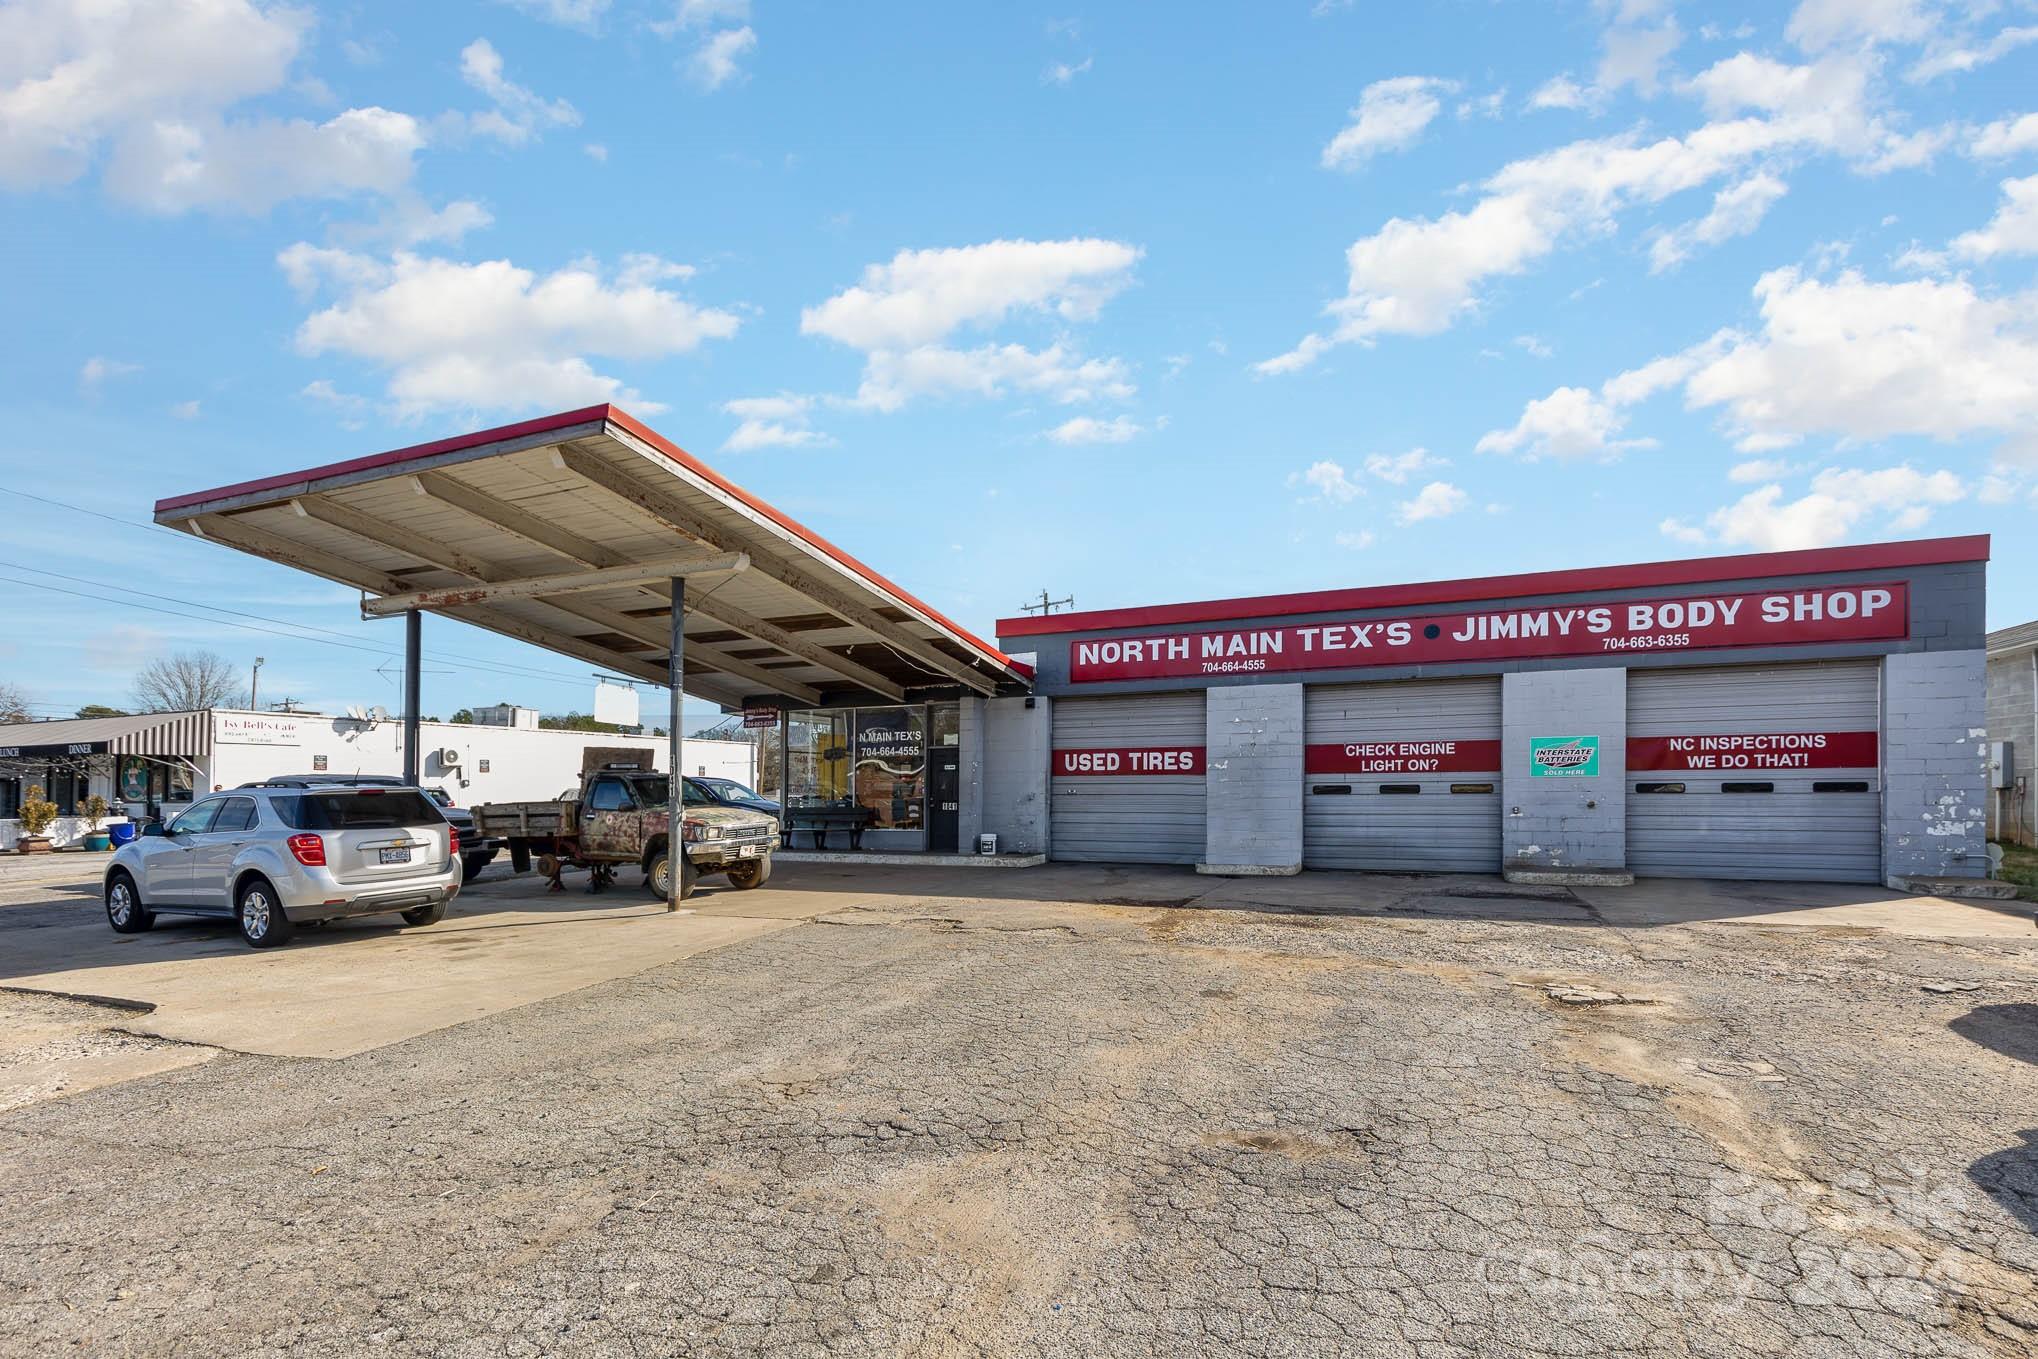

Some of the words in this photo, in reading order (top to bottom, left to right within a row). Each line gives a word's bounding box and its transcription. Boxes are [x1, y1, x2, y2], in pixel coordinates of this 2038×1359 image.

[1079, 637, 1189, 665] NORTH
[1201, 631, 1283, 658] MAIN
[1297, 622, 1412, 649] TEX'S
[1453, 608, 1612, 642] JIMMY'S
[1627, 598, 1743, 631] BODY
[1762, 589, 1892, 623] SHOP
[1603, 634, 1690, 650] 704-663-6355
[1202, 659, 1266, 673] 704-664-4555
[868, 731, 892, 742] MAIN
[894, 731, 922, 741] TEX'S
[1670, 736, 1695, 751] NC
[1699, 734, 1827, 750] INSPECTIONS
[69, 743, 92, 755] DINNER
[861, 746, 919, 757] 704-664-4555
[1346, 743, 1395, 757] CHECK
[1399, 742, 1456, 756] ENGINE
[1536, 748, 1593, 756] INTERSTATE
[1065, 753, 1120, 772] USED
[1129, 751, 1194, 771] TIRES
[1361, 759, 1404, 773] LIGHT
[1407, 758, 1439, 772] ON?
[1687, 754, 1716, 769] WE
[1721, 754, 1748, 769] DO
[1753, 752, 1810, 768] THAT!
